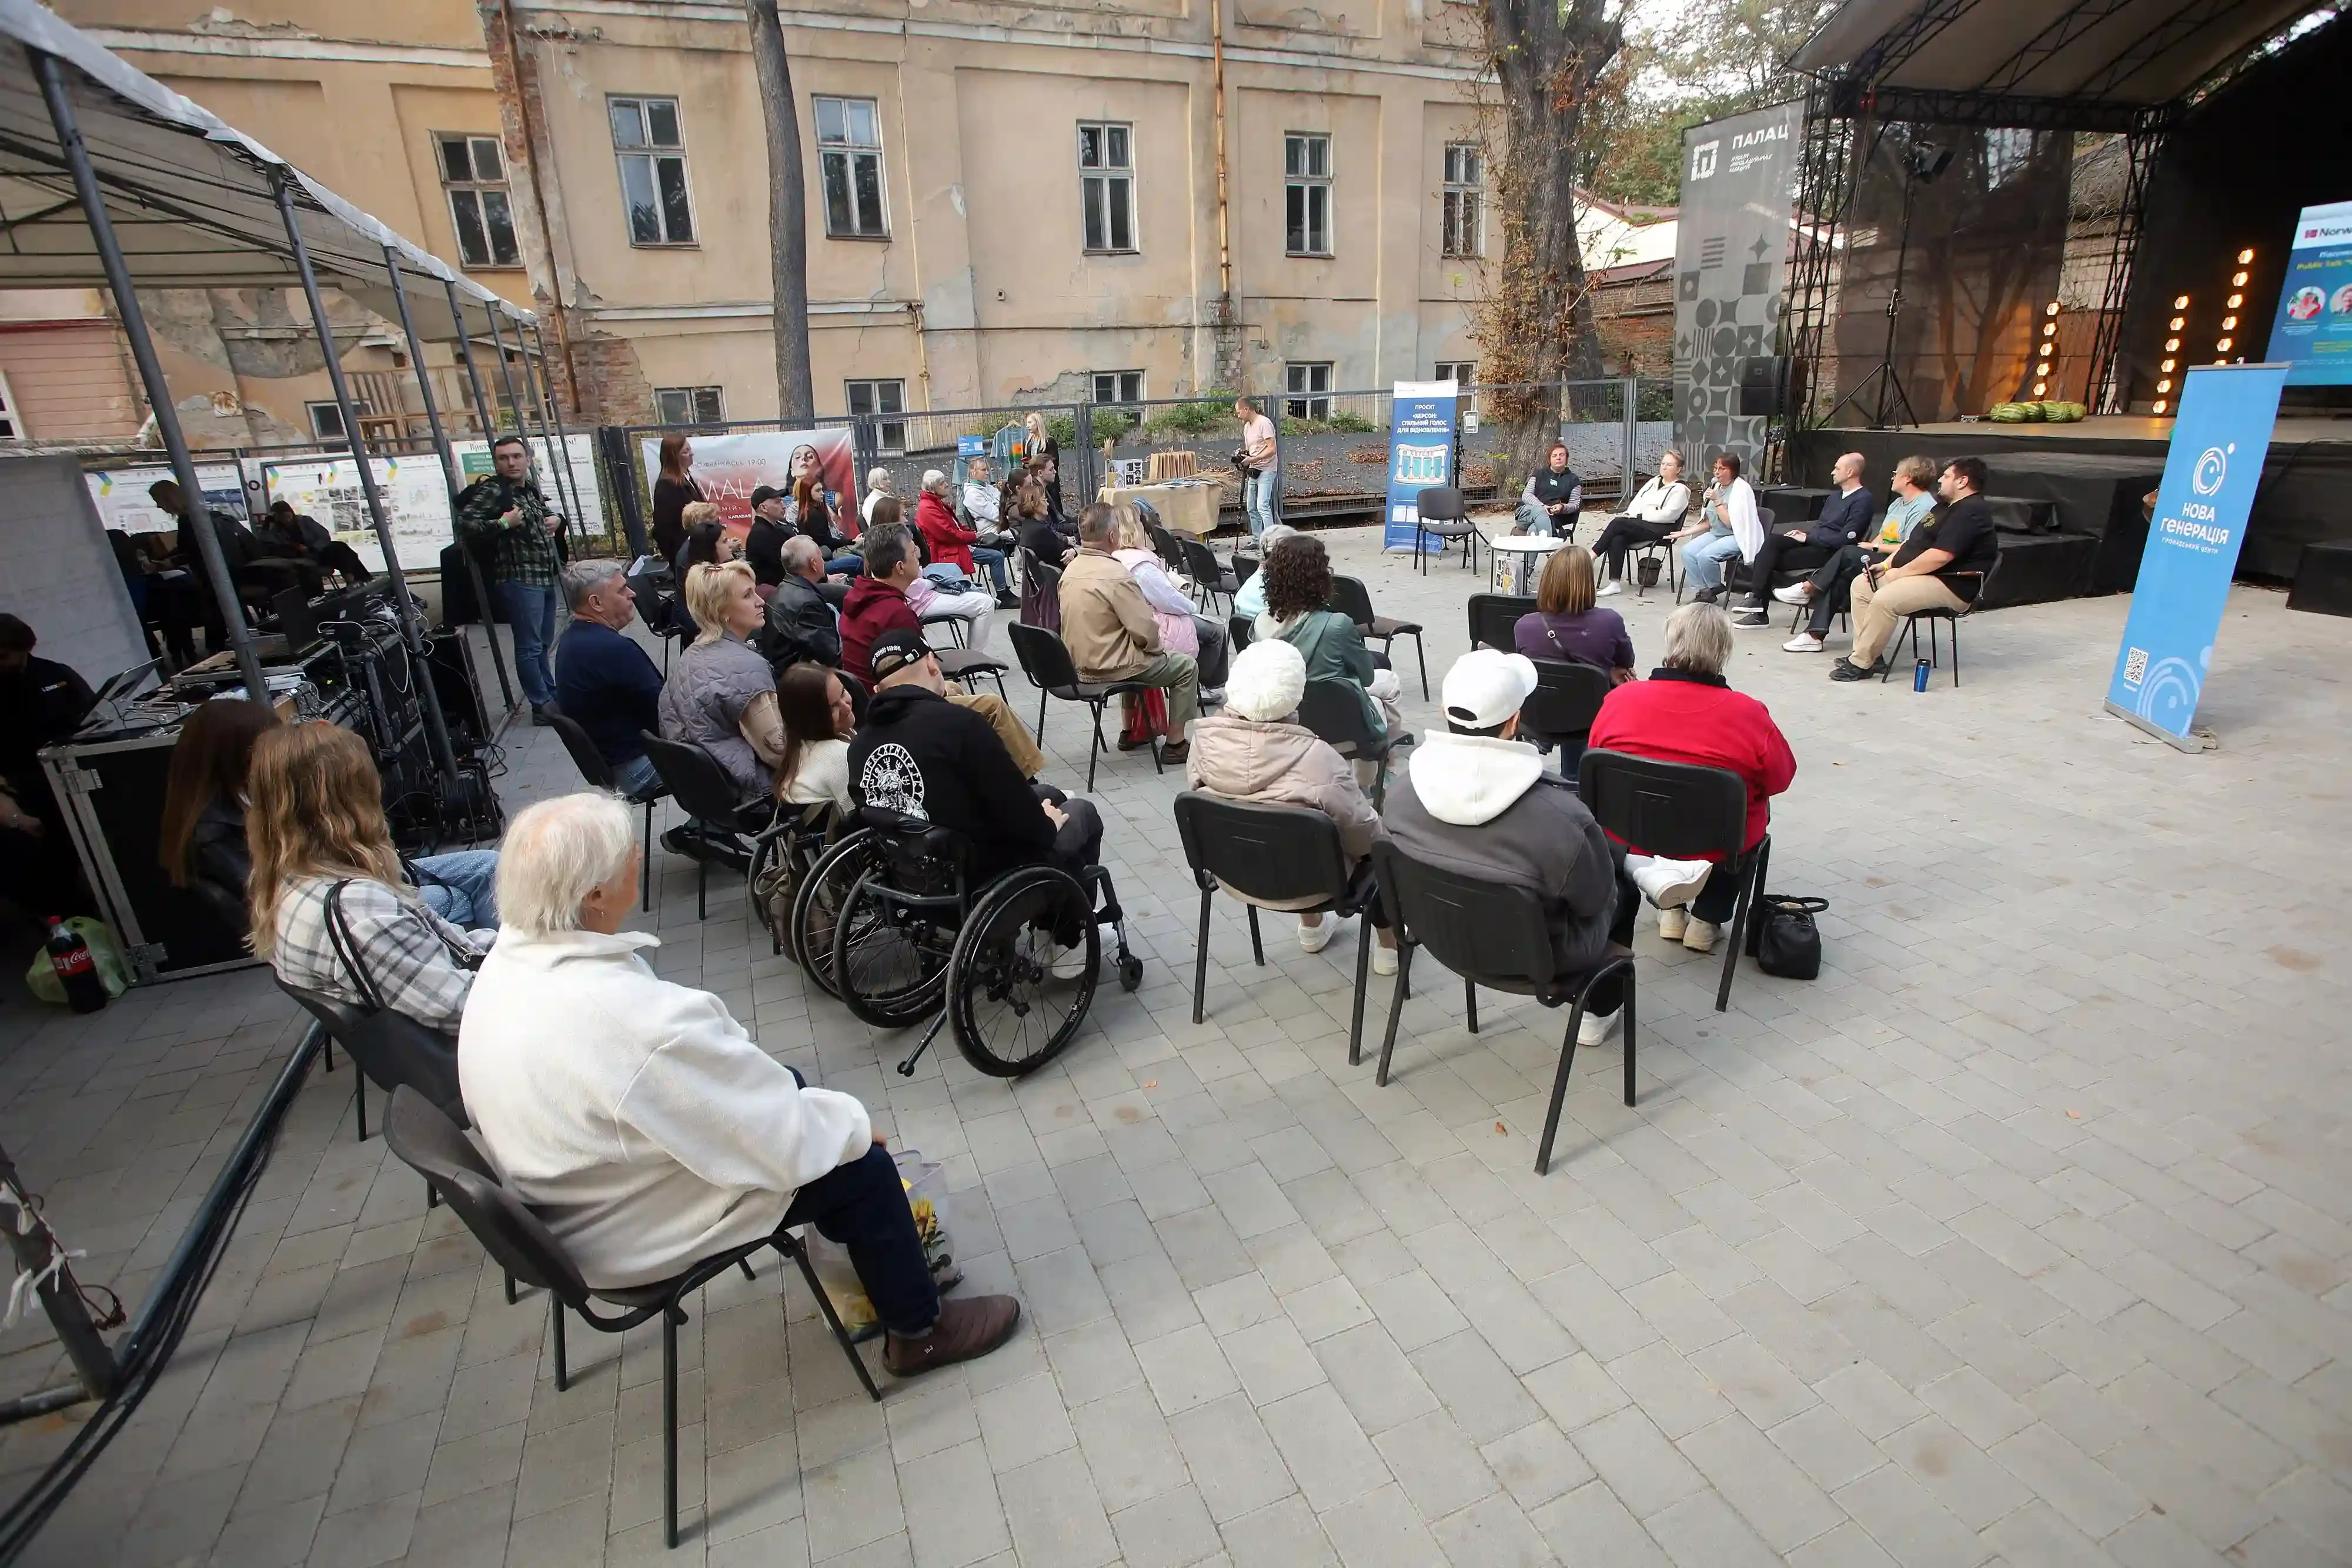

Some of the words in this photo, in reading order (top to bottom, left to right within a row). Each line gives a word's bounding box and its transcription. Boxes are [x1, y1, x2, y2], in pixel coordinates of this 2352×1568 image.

[1732, 124, 1789, 149] ПАЛАЦ
[697, 477, 764, 501] MALA
[2181, 503, 2215, 522] НОВА
[2201, 546, 2219, 554] ЦЕНТР
